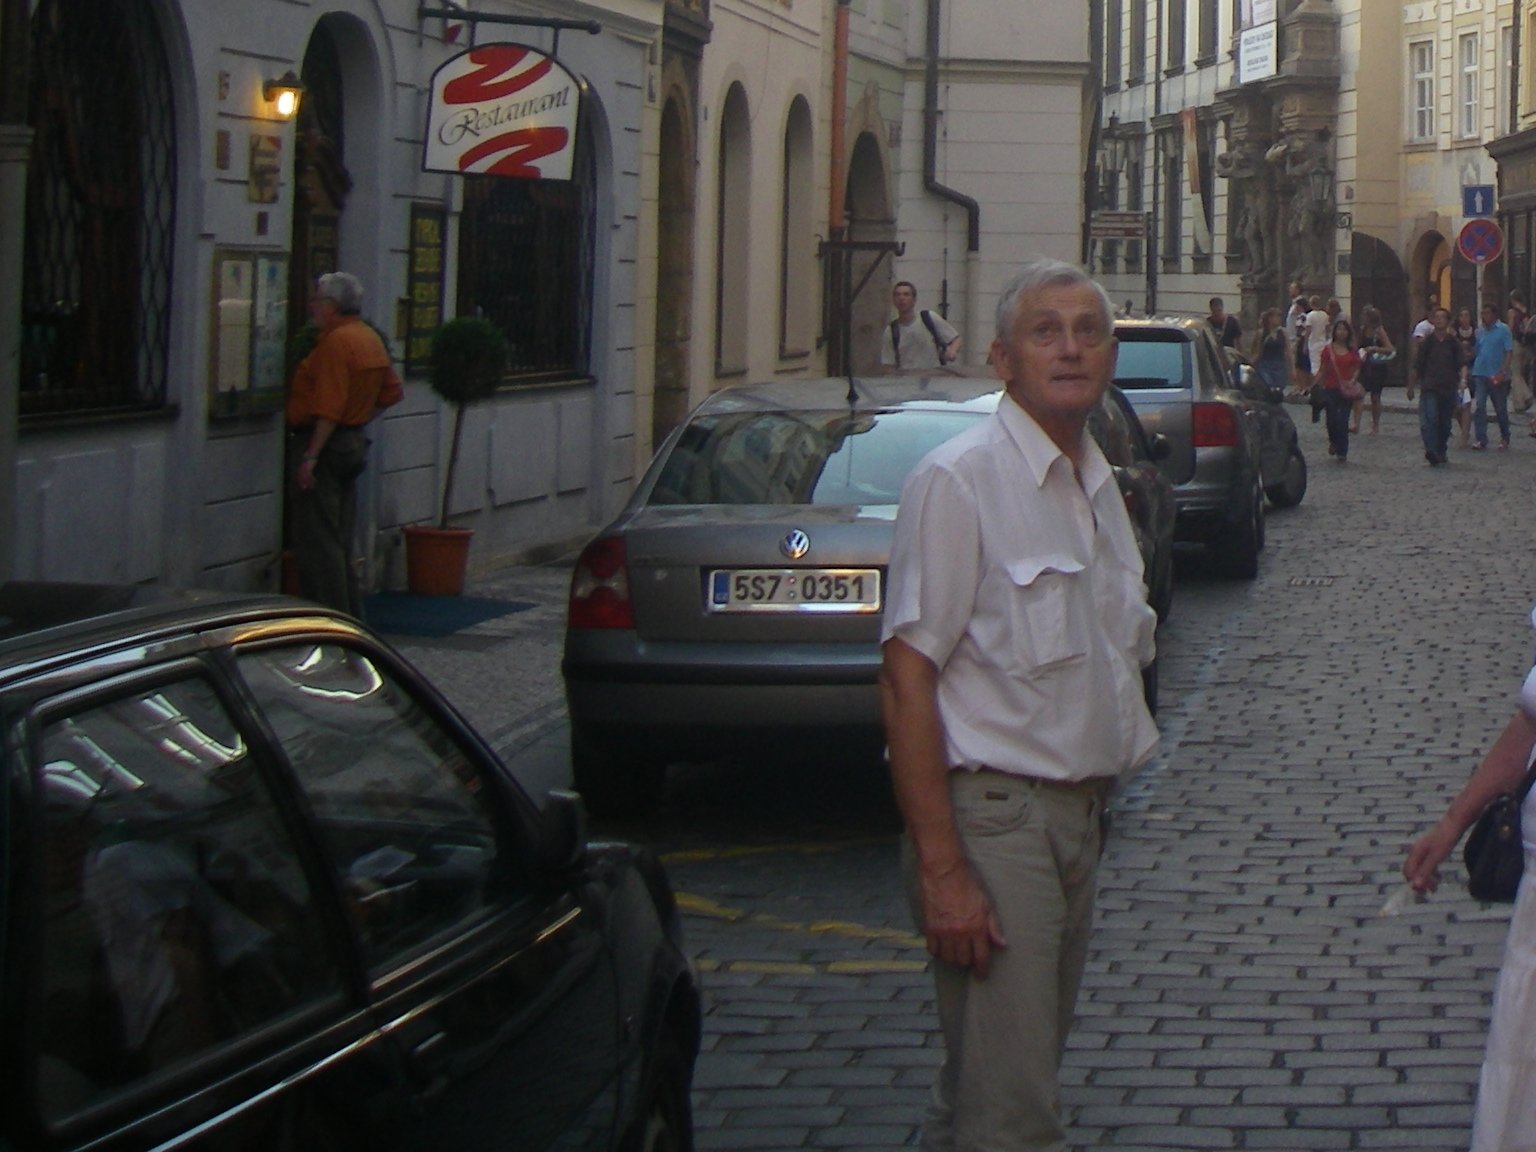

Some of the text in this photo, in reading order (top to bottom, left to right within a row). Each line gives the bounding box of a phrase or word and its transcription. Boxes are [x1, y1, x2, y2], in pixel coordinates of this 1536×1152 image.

[439, 86, 569, 145] Restaurant
[735, 574, 864, 600] 5S7 0351
